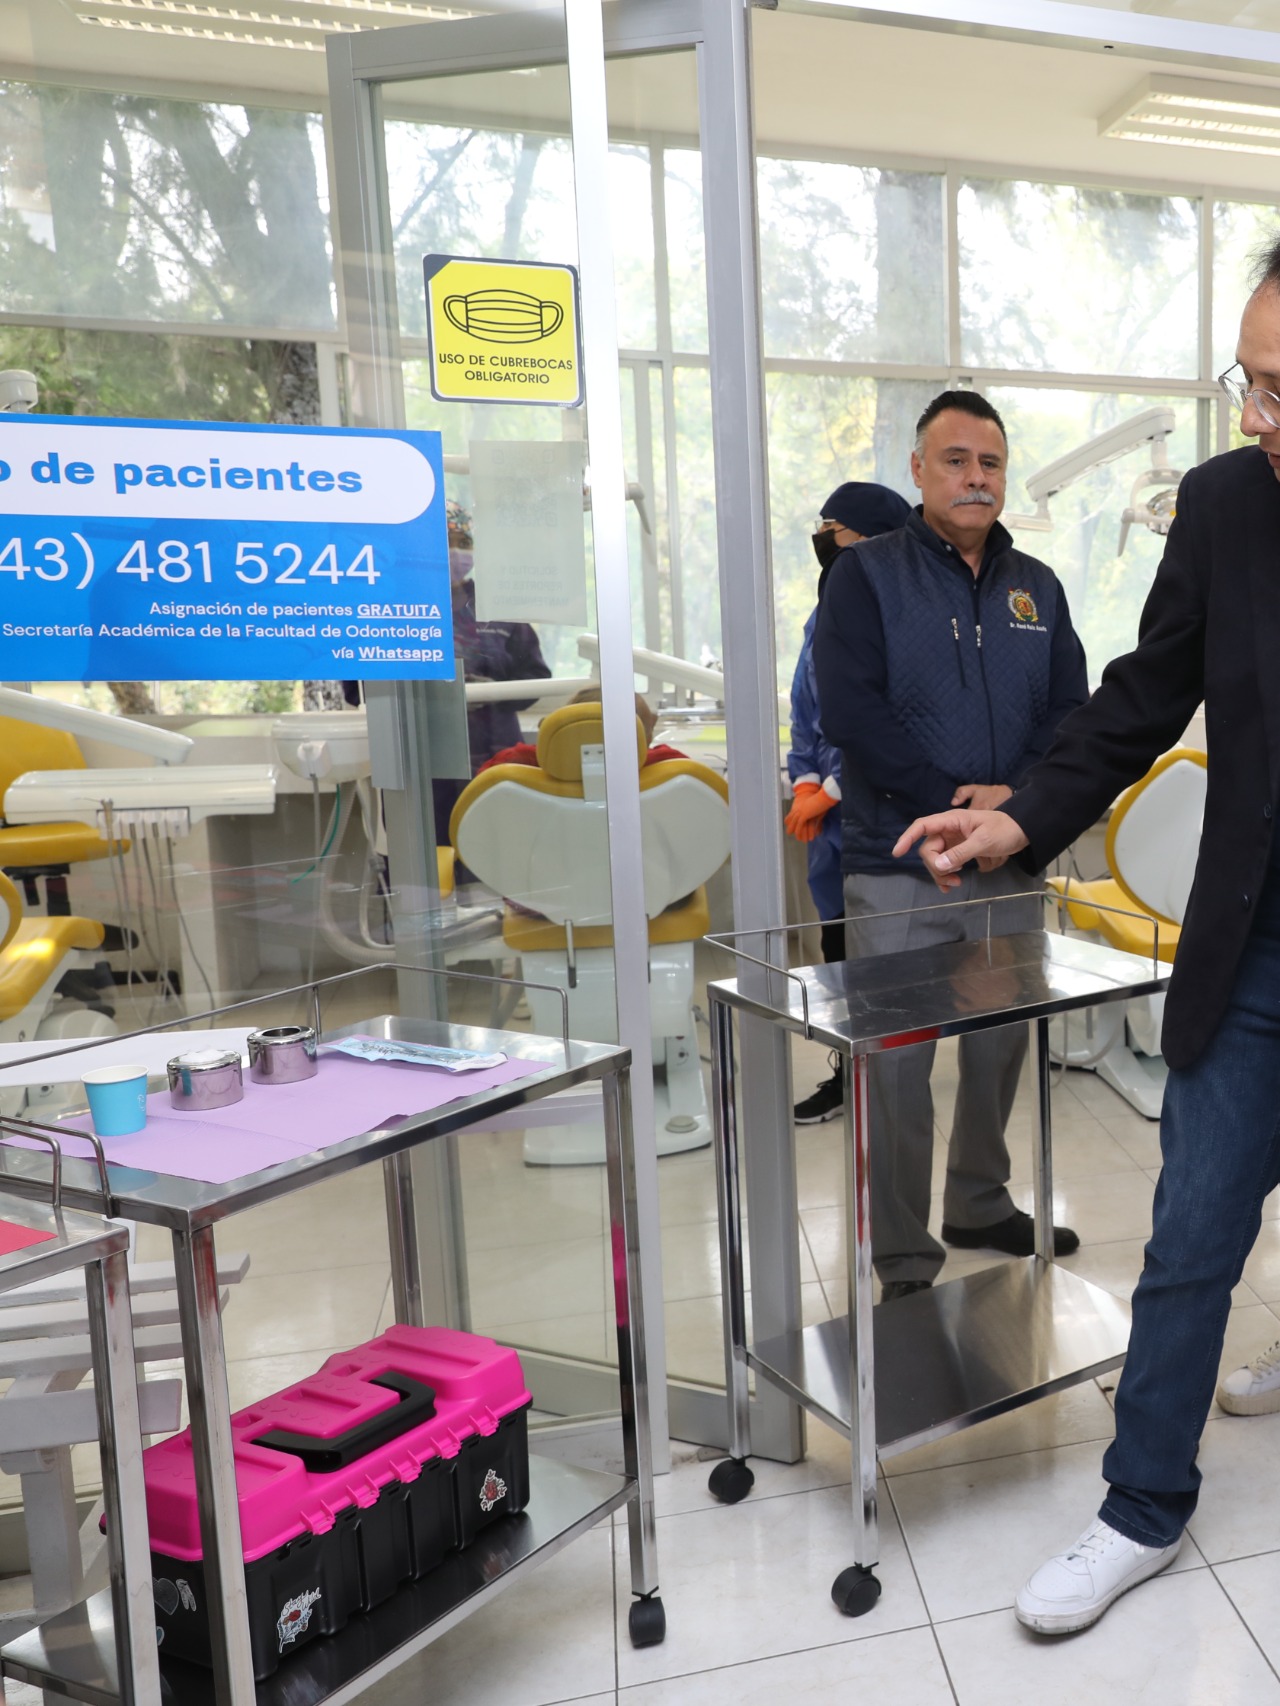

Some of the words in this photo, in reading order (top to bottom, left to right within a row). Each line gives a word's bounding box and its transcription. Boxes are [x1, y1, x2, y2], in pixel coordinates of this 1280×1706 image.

[439, 353, 465, 365] USO
[469, 354, 485, 366] DE
[489, 355, 573, 370] CUBREBOCAS
[464, 370, 550, 384] OBLIGATORIO
[31, 452, 95, 485] de
[114, 458, 363, 495] pacientes
[116, 540, 212, 583] 481
[235, 541, 381, 586] 5244
[150, 601, 242, 618] Asignación
[247, 603, 268, 616] de
[273, 603, 353, 619] pacientes
[357, 604, 442, 618] GRATUITA
[2, 623, 94, 637] Secretaría
[98, 623, 196, 638] Académica
[200, 624, 222, 638] de
[226, 624, 241, 638] la
[245, 624, 316, 638] Facultad
[320, 625, 342, 638] de
[346, 624, 443, 641] Odontología
[331, 646, 354, 659] vía
[358, 646, 444, 663] Whatsapp
